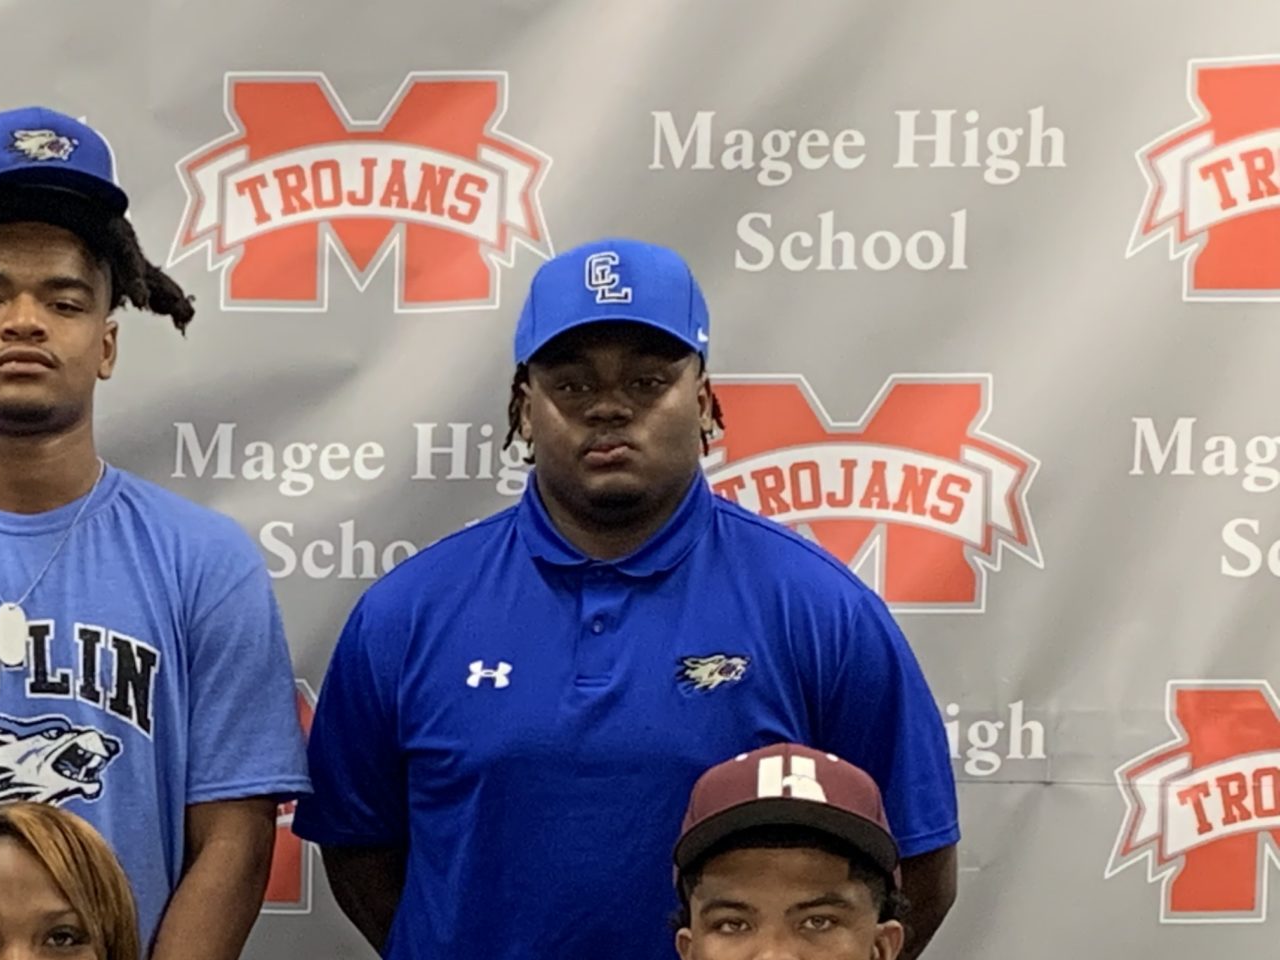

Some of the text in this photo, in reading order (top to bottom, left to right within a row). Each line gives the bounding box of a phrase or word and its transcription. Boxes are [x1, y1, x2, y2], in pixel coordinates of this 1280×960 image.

[648, 106, 1067, 186] Magee High
[236, 157, 489, 226] TROJANS
[735, 209, 968, 271] School
[171, 422, 533, 496] Magee Hig
[259, 520, 422, 580] Scho
[946, 700, 1047, 776] igh
